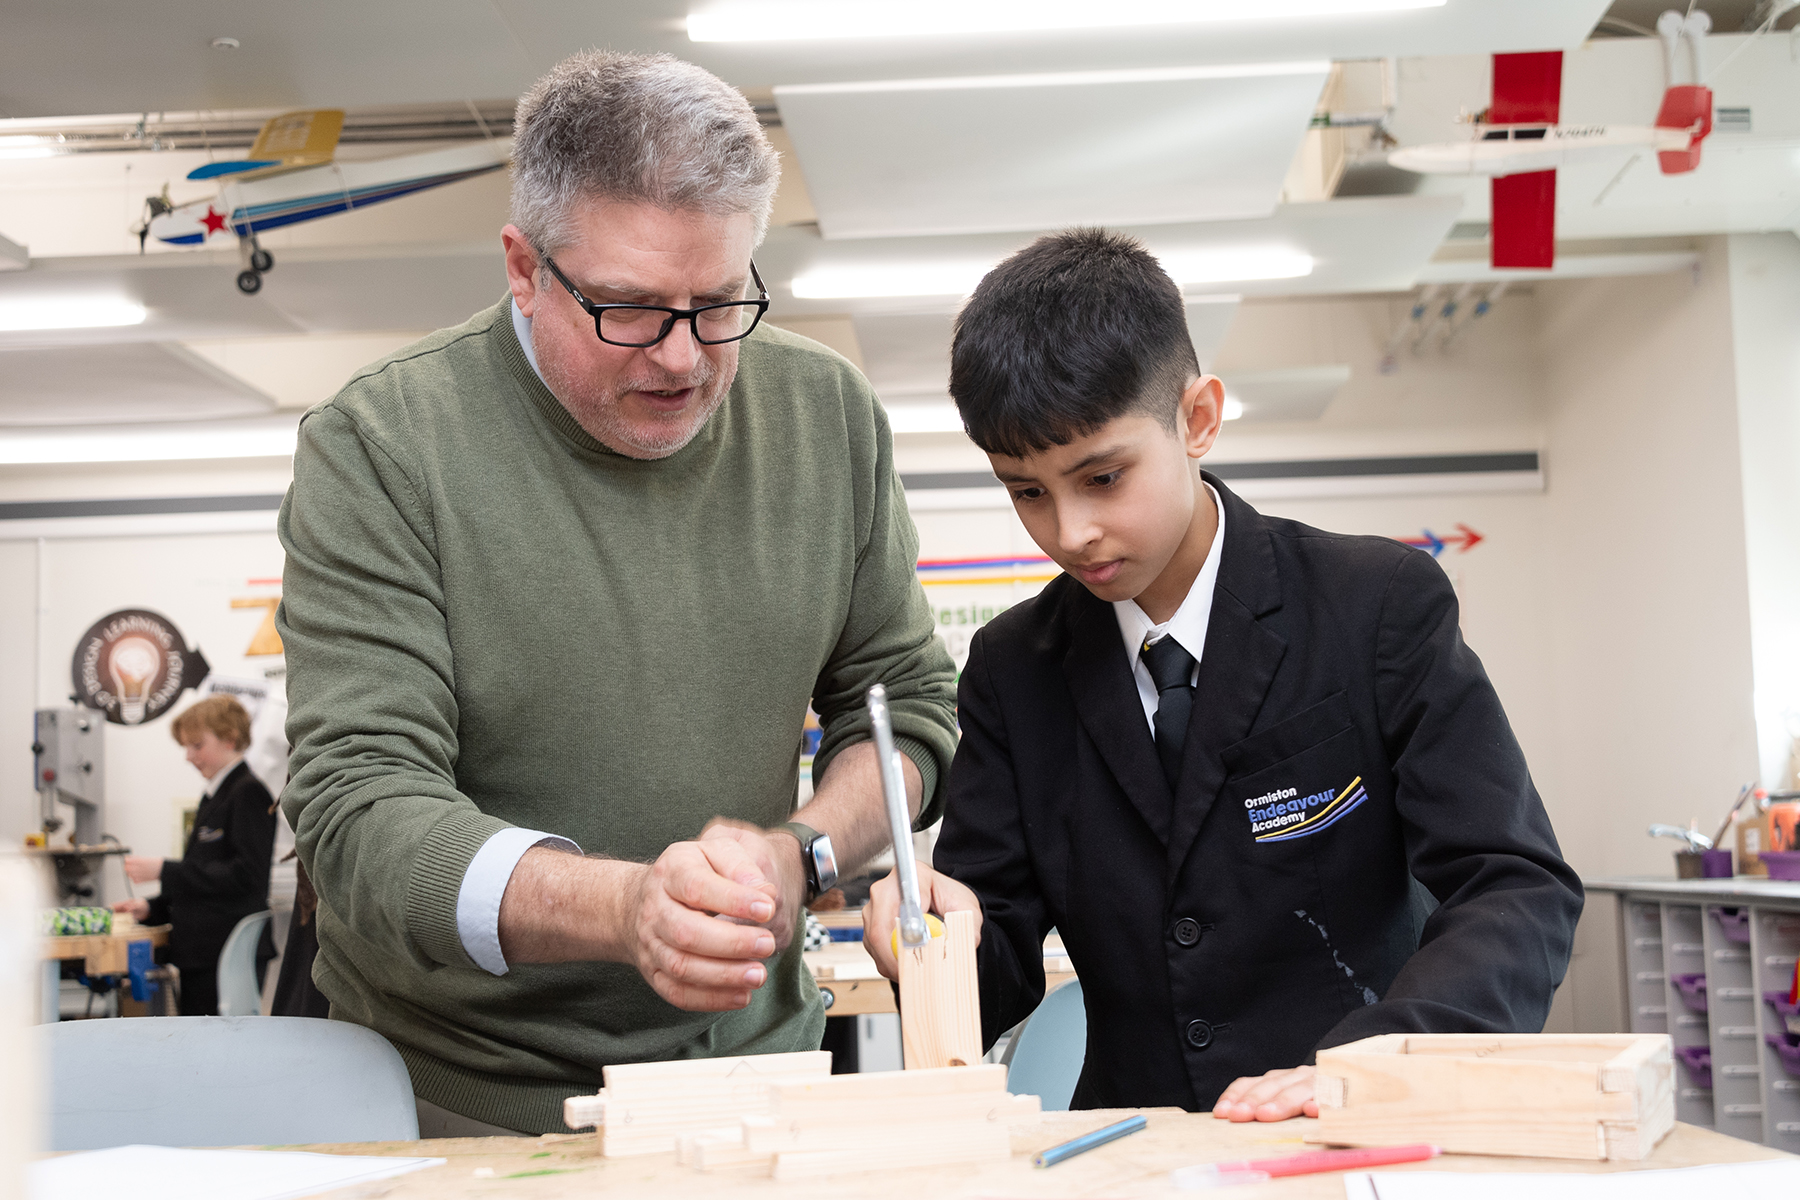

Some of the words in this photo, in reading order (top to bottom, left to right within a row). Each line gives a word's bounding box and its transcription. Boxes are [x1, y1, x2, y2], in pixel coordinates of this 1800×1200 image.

[930, 602, 1010, 627] esig
[82, 637, 104, 697] DESIGN
[102, 615, 174, 650] LEARNING
[147, 650, 184, 713] JOURNEY
[1244, 787, 1298, 809] Ormiston
[1247, 788, 1336, 823] Endeavour
[1251, 811, 1306, 833] Academy
